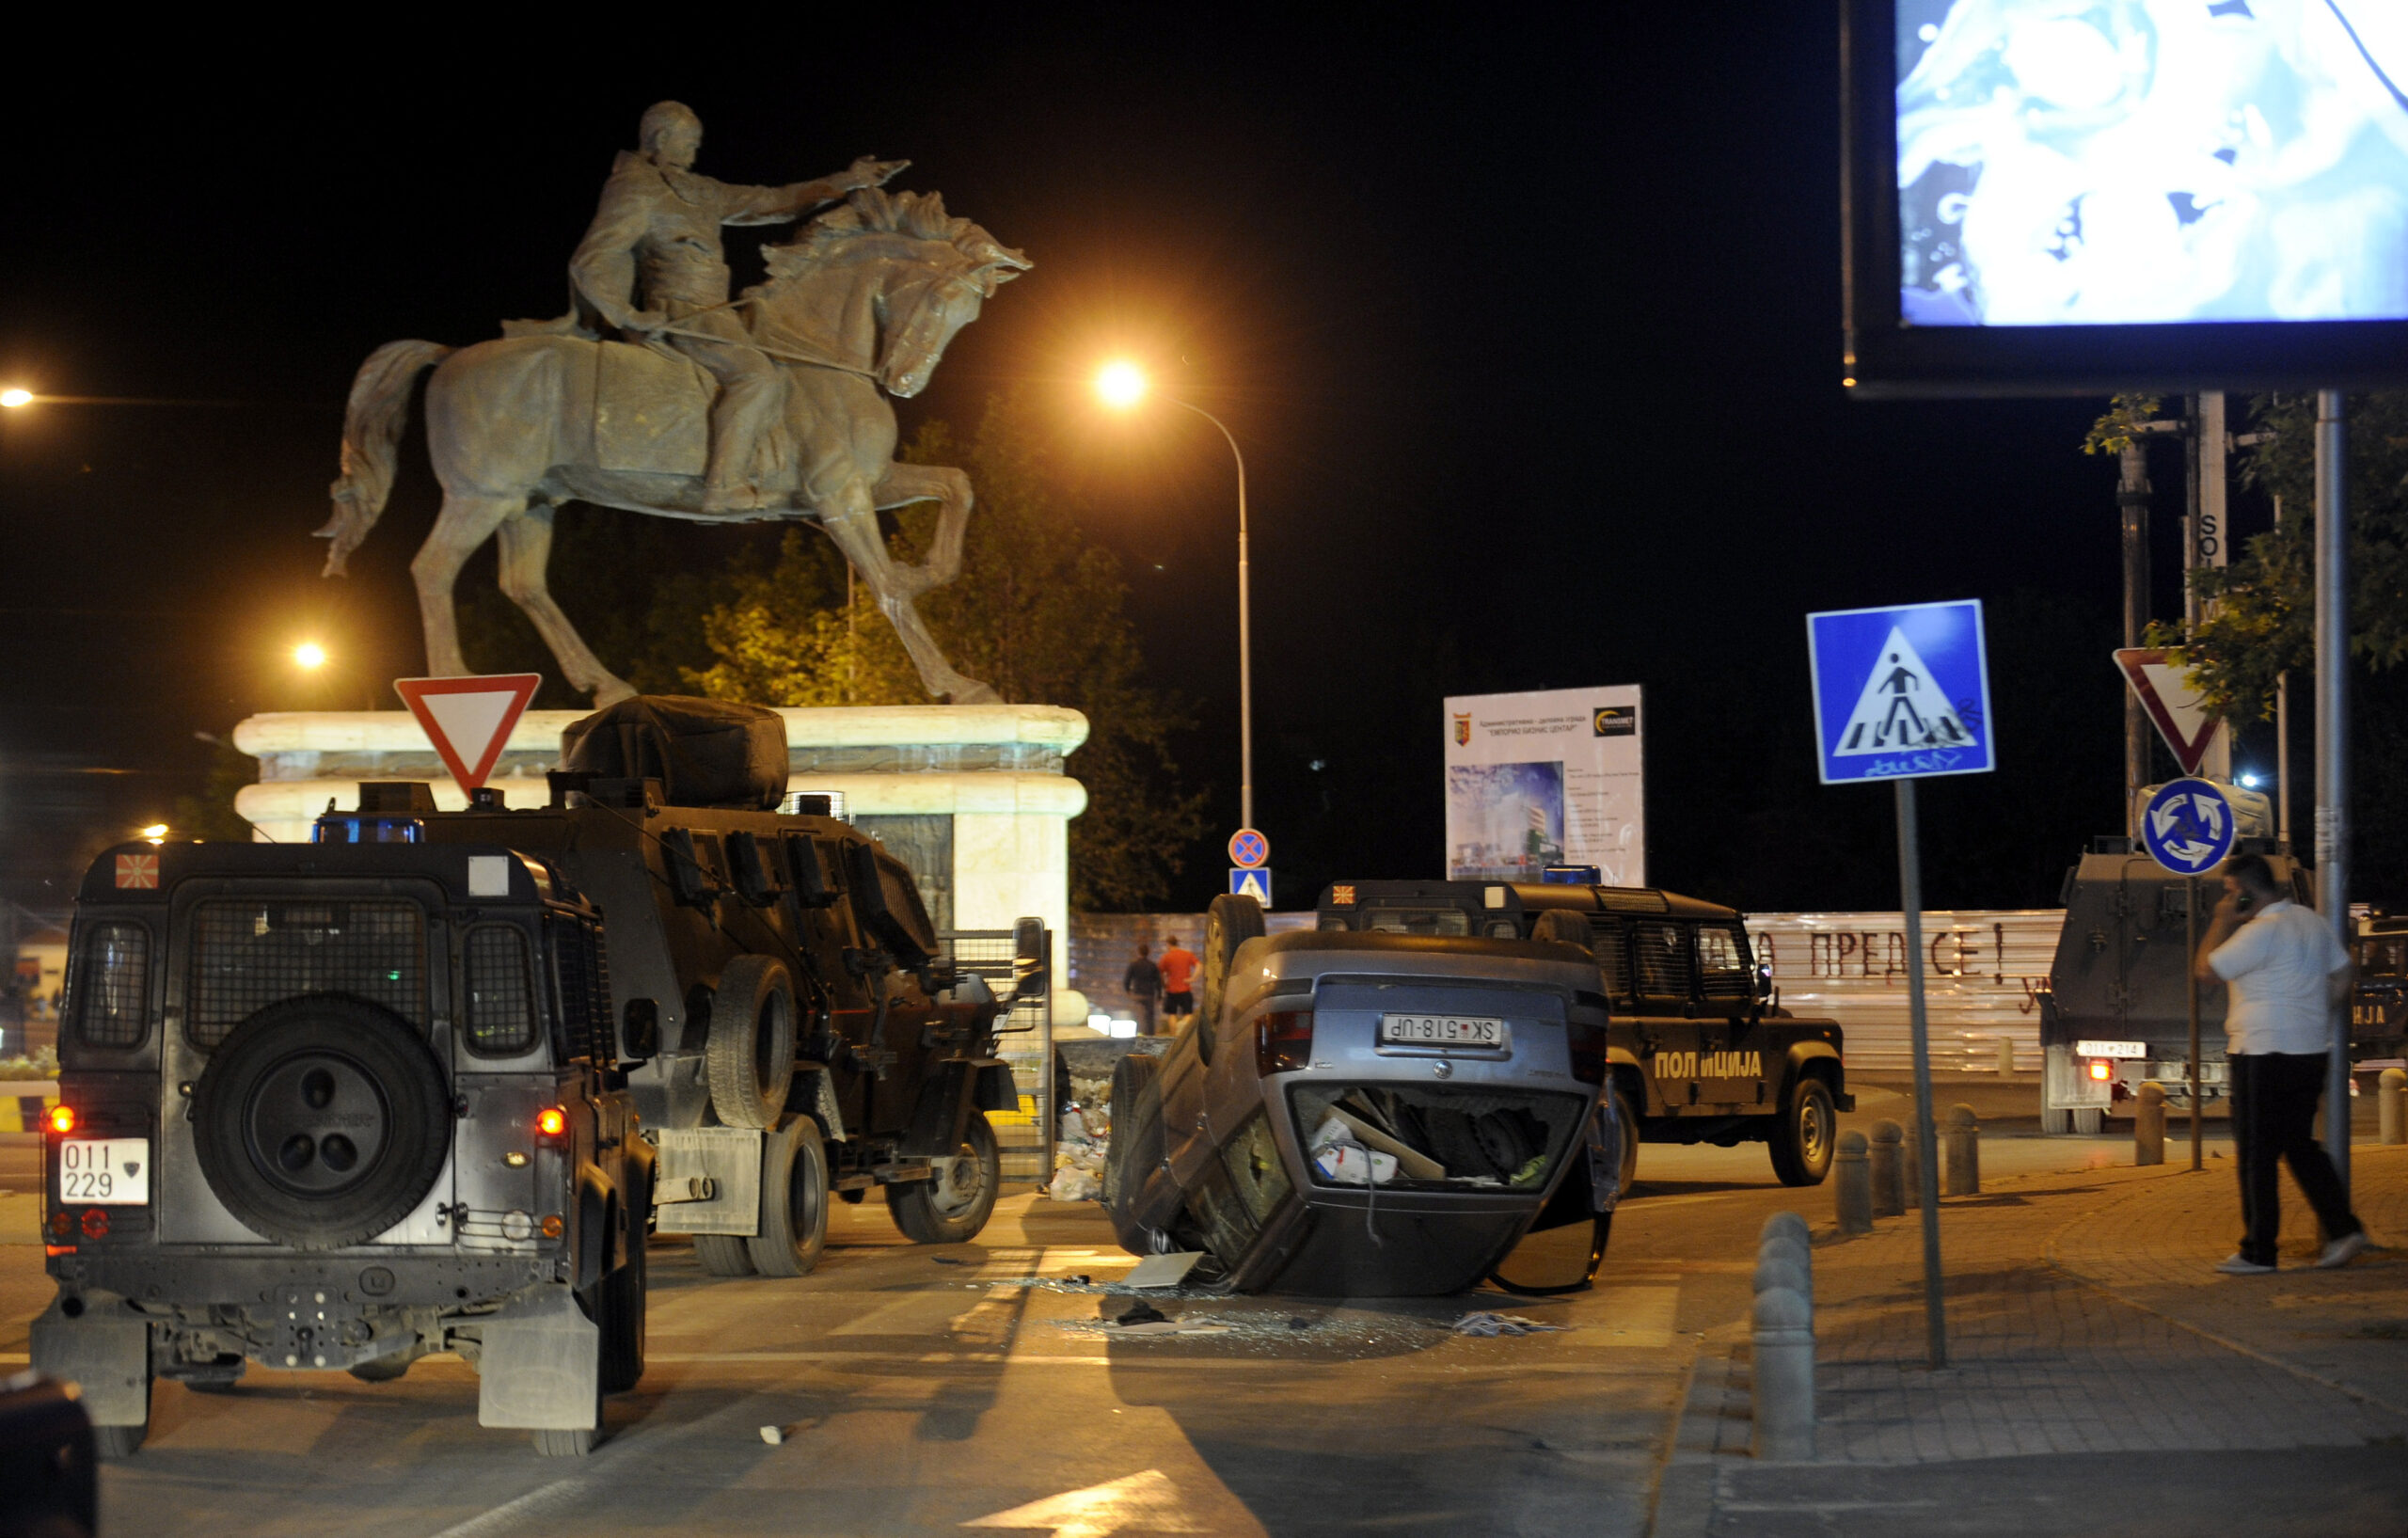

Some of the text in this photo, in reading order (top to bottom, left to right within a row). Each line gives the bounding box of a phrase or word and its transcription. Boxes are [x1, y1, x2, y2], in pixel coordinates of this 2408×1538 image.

[1390, 1017, 1494, 1039] SK 518-UP
[2117, 1043, 2137, 1054] 214
[1655, 1051, 1763, 1081] ПОЛИЦИЈА
[65, 1144, 109, 1170] 011
[65, 1172, 113, 1198] 229
